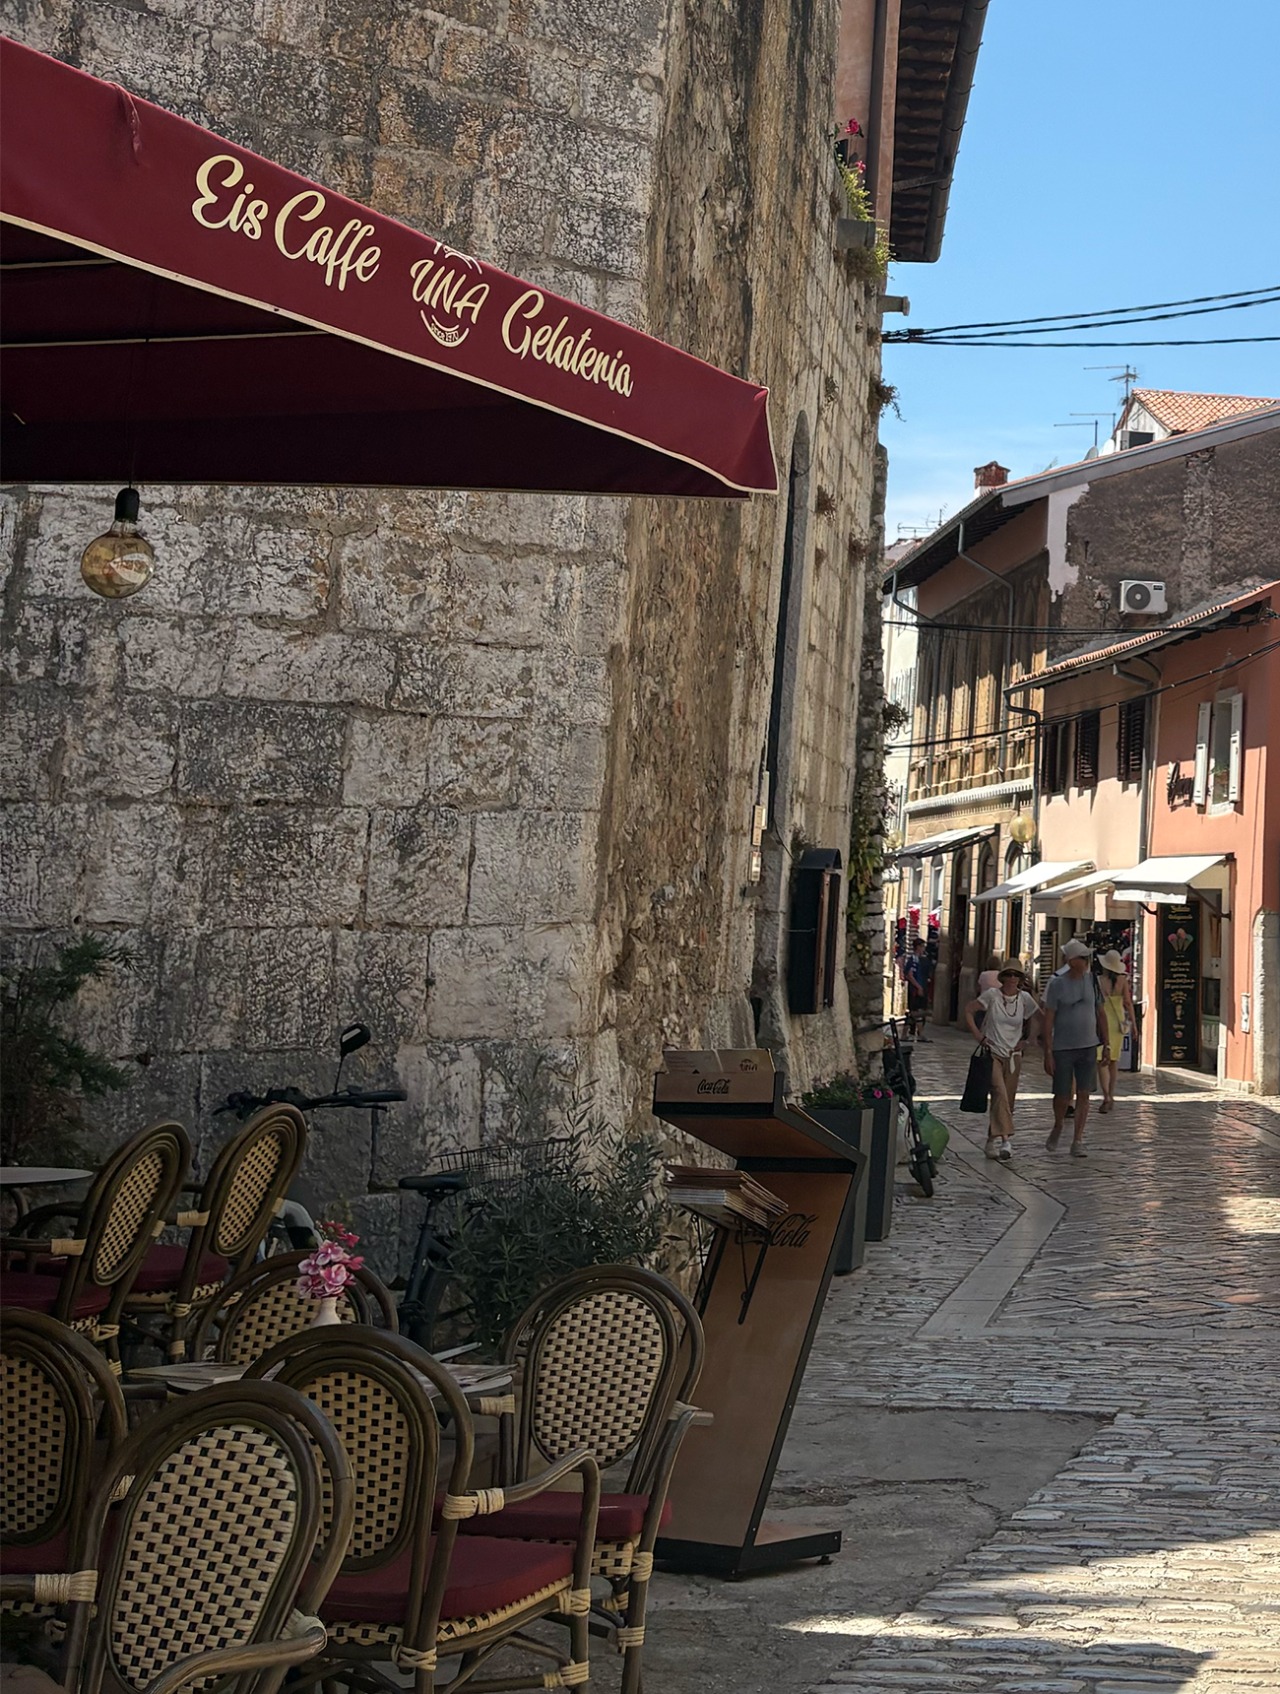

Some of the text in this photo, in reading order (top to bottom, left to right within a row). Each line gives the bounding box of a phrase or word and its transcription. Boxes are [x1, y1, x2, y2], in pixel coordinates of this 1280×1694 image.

[192, 154, 382, 291] Eis Caffe
[410, 259, 490, 325] UNA
[501, 289, 634, 398] Gelateria
